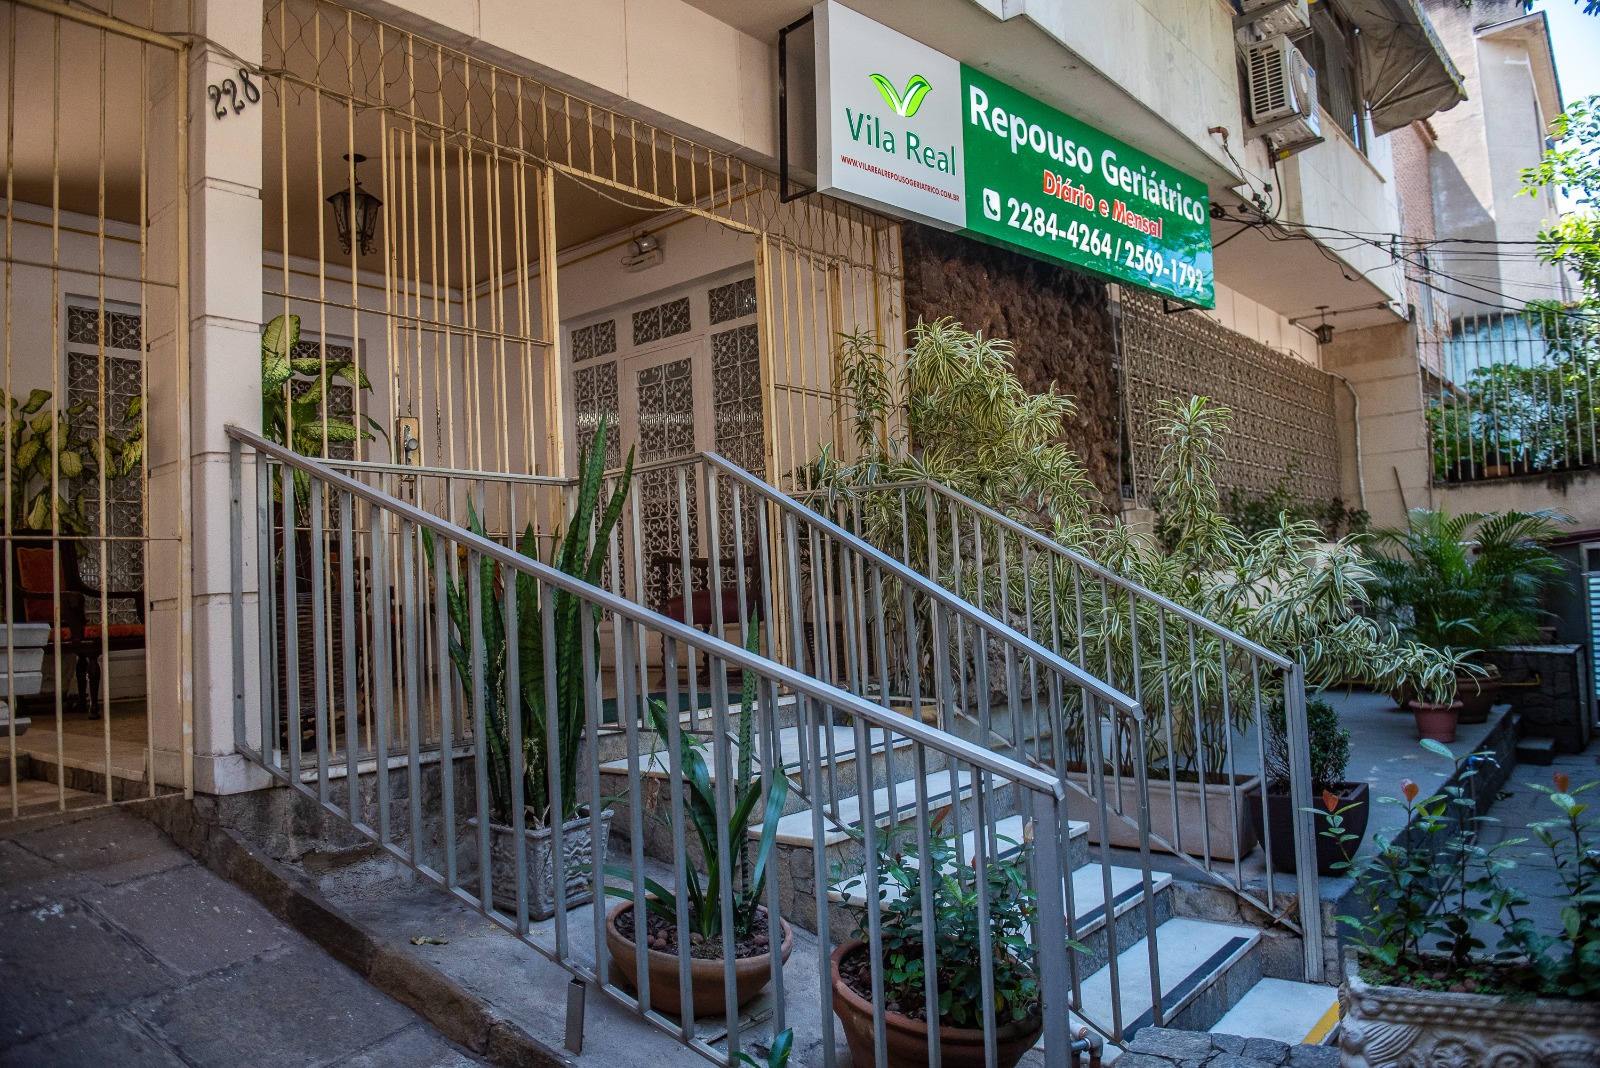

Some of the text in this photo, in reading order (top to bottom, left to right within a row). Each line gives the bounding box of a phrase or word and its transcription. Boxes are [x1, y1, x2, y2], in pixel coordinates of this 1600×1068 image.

[208, 68, 260, 120] 228
[845, 107, 957, 176] Vila Real
[969, 84, 1205, 225] Repouso Geriátrico
[840, 154, 960, 202] WWW.VILAREALREPOUSOGERIATRICO.COM.BR
[1043, 169, 1163, 239] Diário e Mensal
[1007, 197, 1112, 260] 2284-4264
[1124, 240, 1204, 293] 2569-1792
